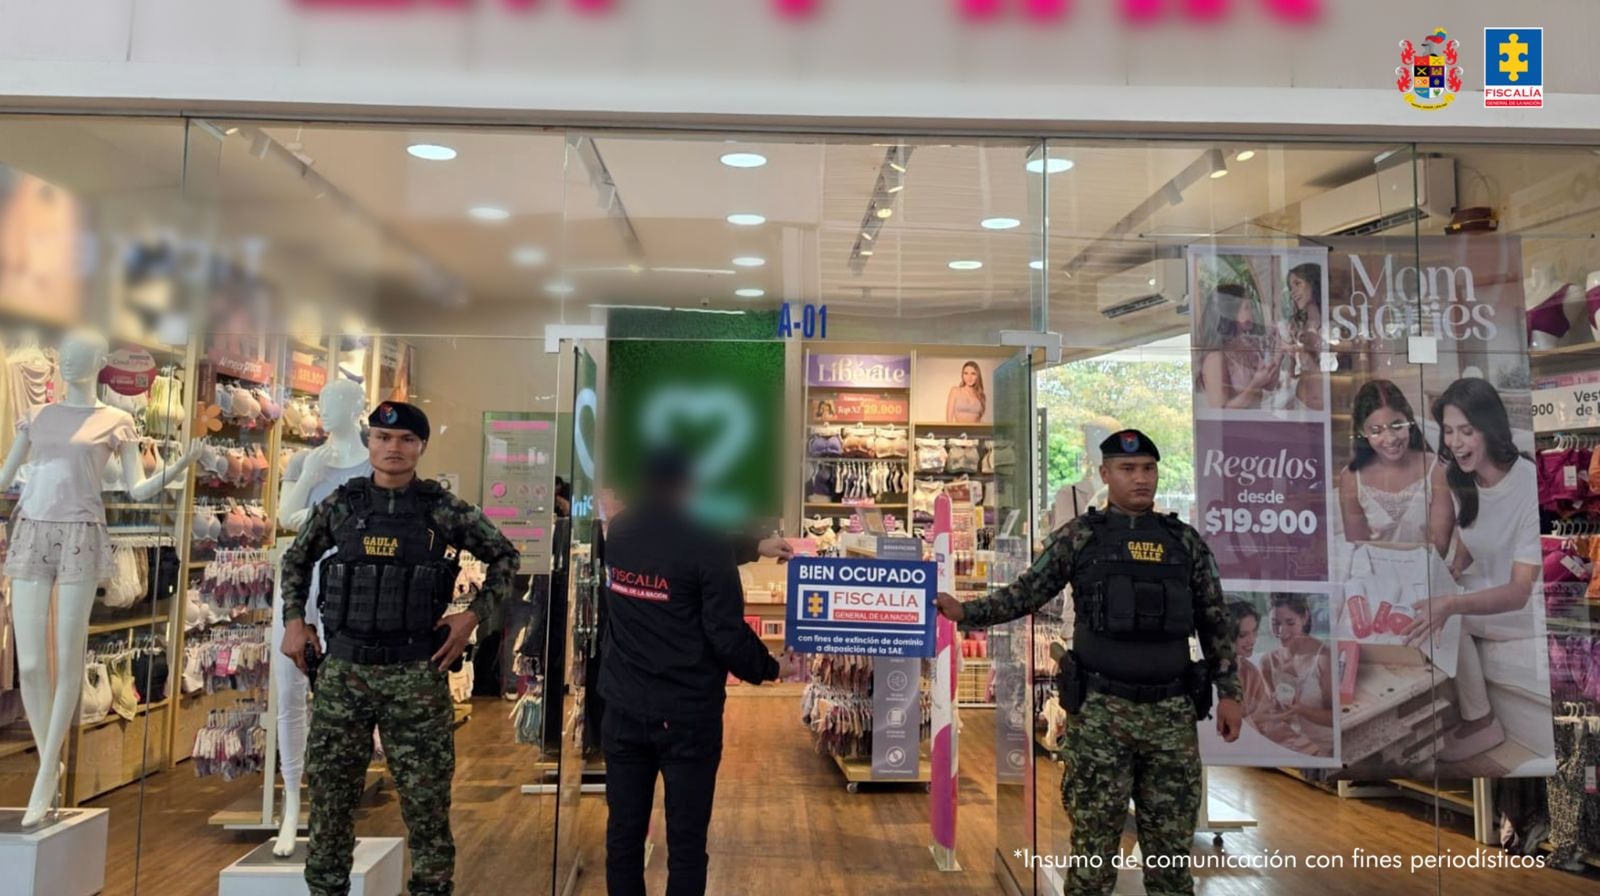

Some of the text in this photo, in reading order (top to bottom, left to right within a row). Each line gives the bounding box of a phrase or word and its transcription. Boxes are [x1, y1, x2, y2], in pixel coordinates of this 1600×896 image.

[1348, 254, 1477, 302] Mom
[777, 303, 827, 338] A-01
[818, 358, 906, 383] Libérate
[1576, 404, 1593, 416] de
[1203, 448, 1318, 486] Regalos
[1237, 489, 1285, 503] desde
[1205, 507, 1318, 535] $19.900
[363, 536, 398, 547] GAULA
[1127, 541, 1164, 553] GAULA
[365, 546, 395, 556] VALLE
[1130, 551, 1161, 561] VALLE
[799, 565, 926, 584] BIEN OCUPADO
[833, 591, 918, 607] FISCALÍA
[835, 611, 917, 622] GENERAL DE LA NACIÓN
[814, 635, 831, 643] fines
[845, 636, 879, 645] extinción
[881, 636, 891, 644] de
[893, 638, 923, 646] dominio
[824, 645, 865, 655] disposición
[867, 646, 877, 654] de
[879, 646, 887, 654] la
